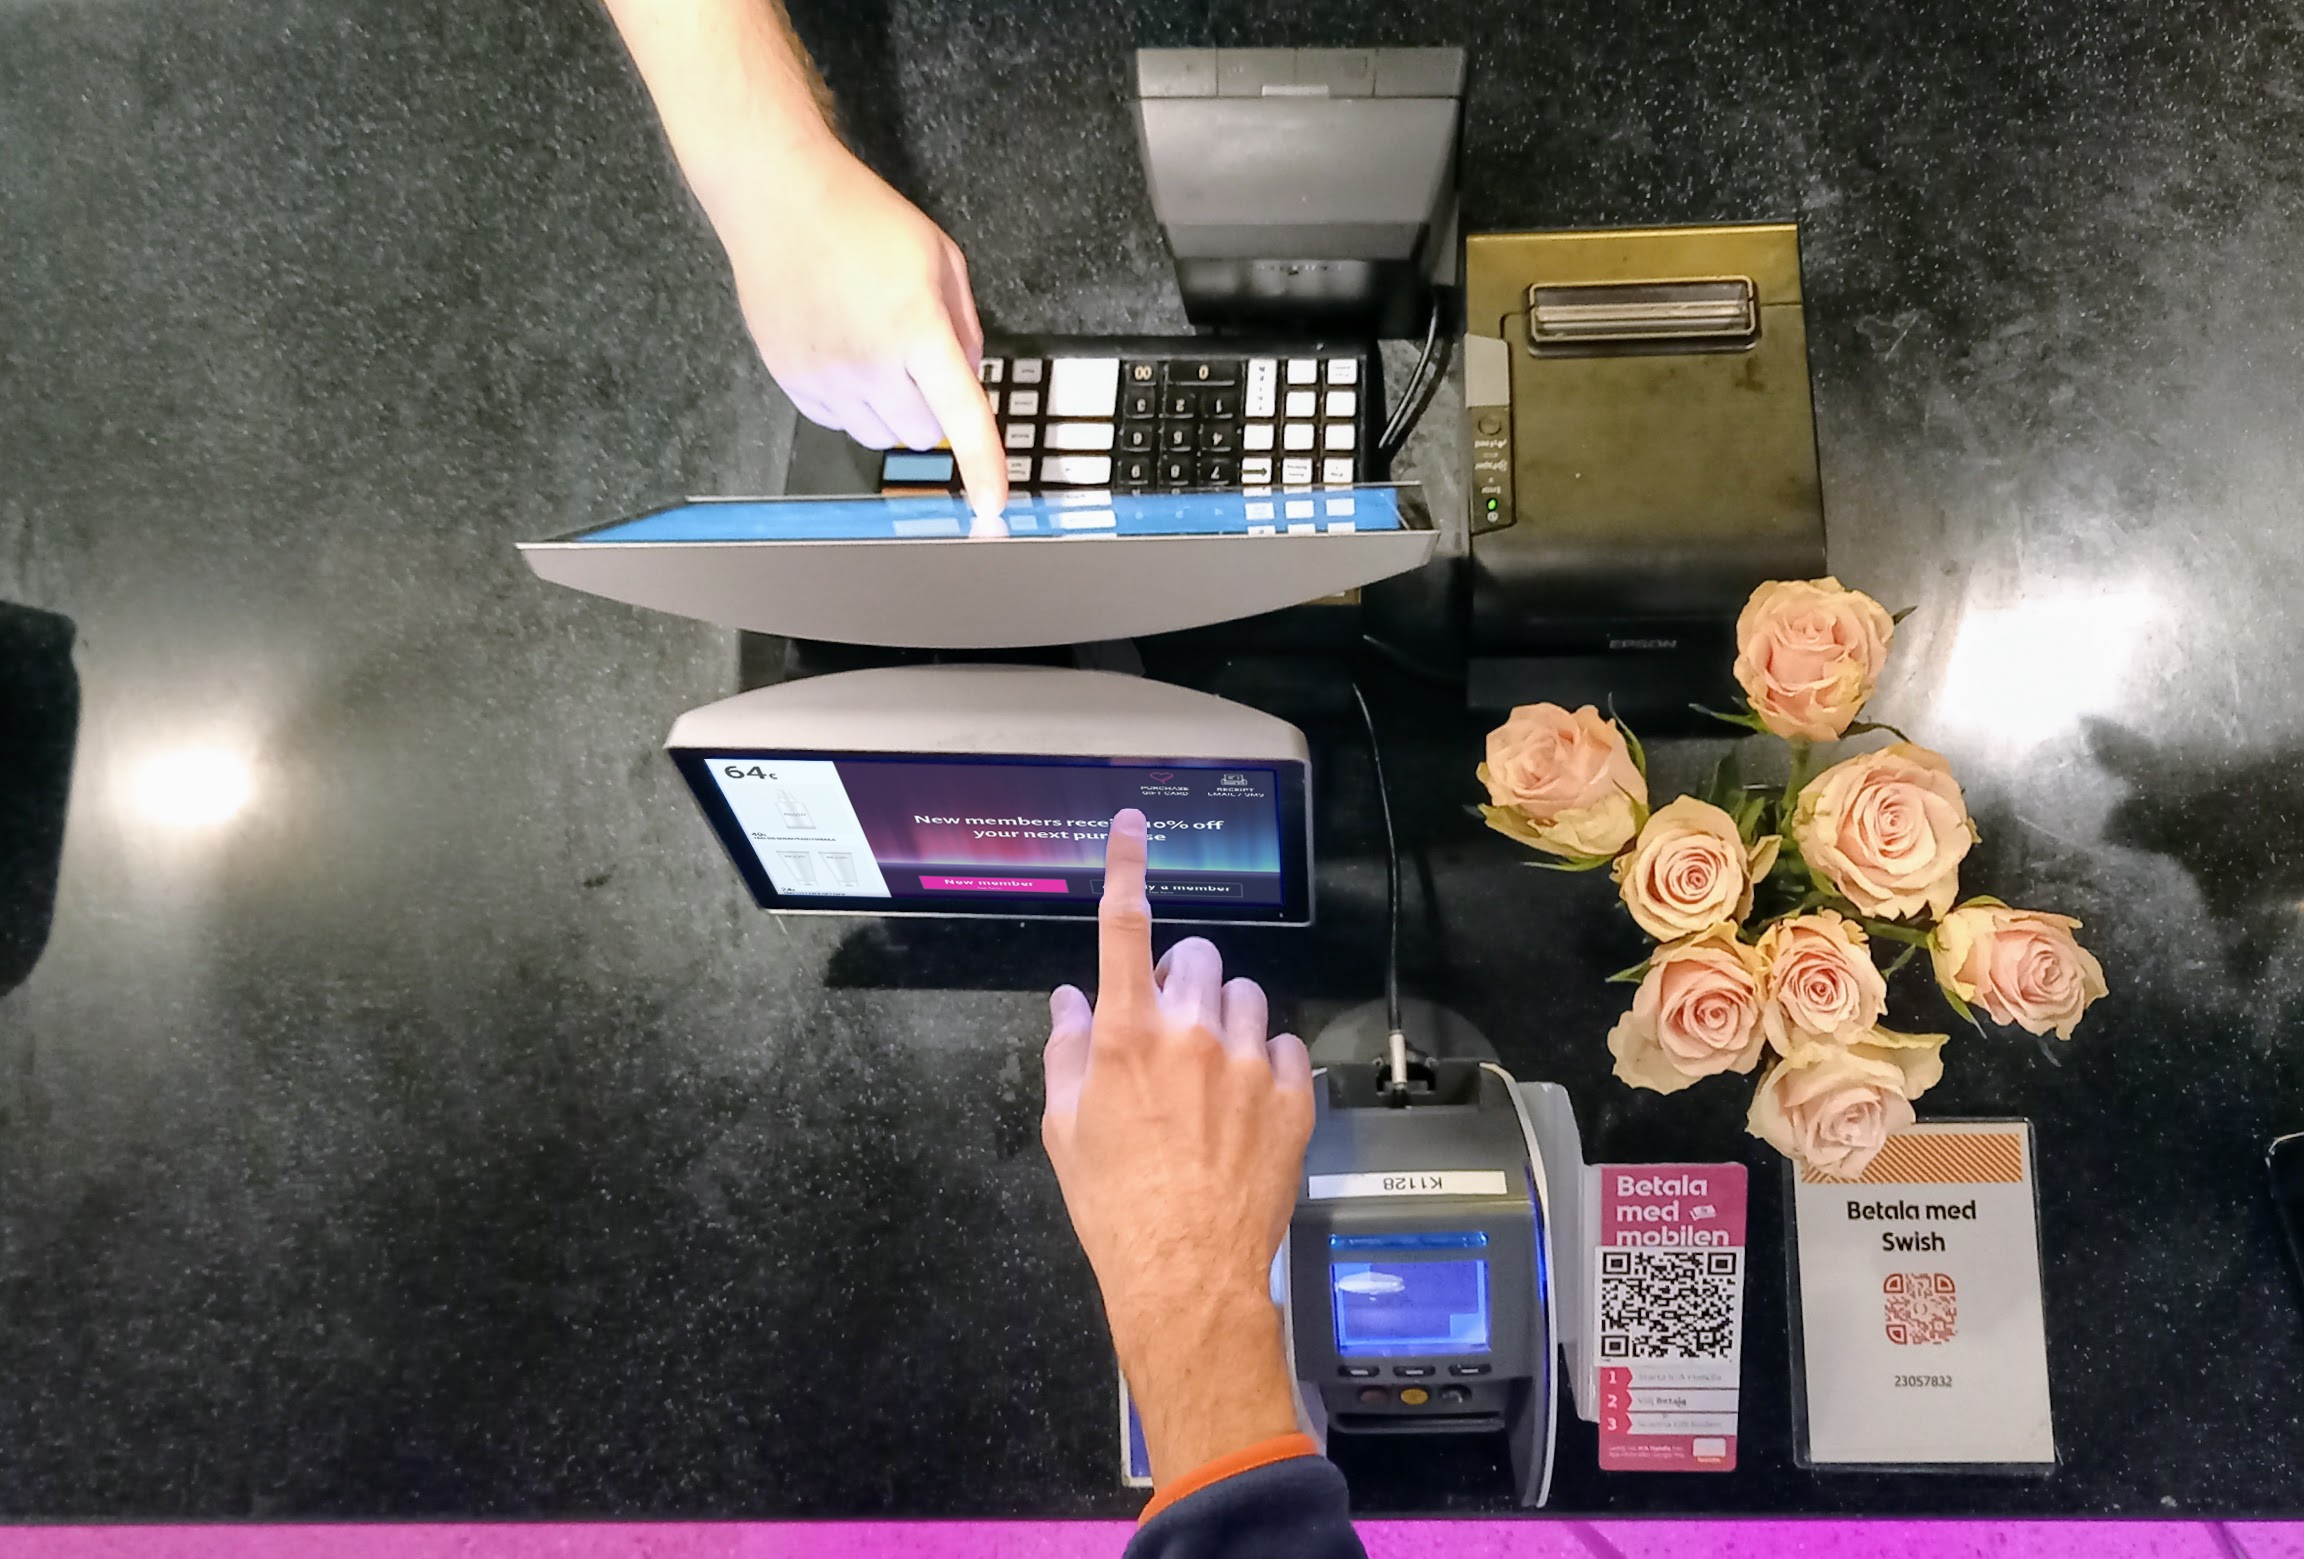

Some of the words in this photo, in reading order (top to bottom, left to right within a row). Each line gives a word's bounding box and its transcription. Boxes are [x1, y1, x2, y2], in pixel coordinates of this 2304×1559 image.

[1134, 365, 1152, 380] 00
[1198, 364, 1209, 380] 0
[1175, 398, 1185, 412] 2
[1216, 399, 1222, 413] 1
[1173, 431, 1183, 444] 5
[1212, 432, 1223, 446] 4
[1211, 465, 1220, 479] 7
[1609, 639, 1677, 649] EPSON
[914, 815, 961, 824] New
[965, 817, 1062, 827] members
[1193, 820, 1225, 830] off
[973, 830, 1020, 839] your
[1024, 830, 1070, 839] next
[978, 879, 1034, 887] member
[1173, 884, 1231, 892] member
[1383, 1176, 1442, 1190] K1128
[1617, 1174, 1708, 1196] Betala
[1616, 1199, 1679, 1222] med
[1847, 1199, 1920, 1220] Betala
[1926, 1199, 1977, 1220] med
[1616, 1225, 1729, 1246] mobilen
[1882, 1231, 1946, 1252] Swish
[1609, 1371, 1617, 1384] 1
[1894, 1375, 1952, 1387] 23057832
[1607, 1394, 1617, 1408] 2
[1607, 1417, 1617, 1431] 3
